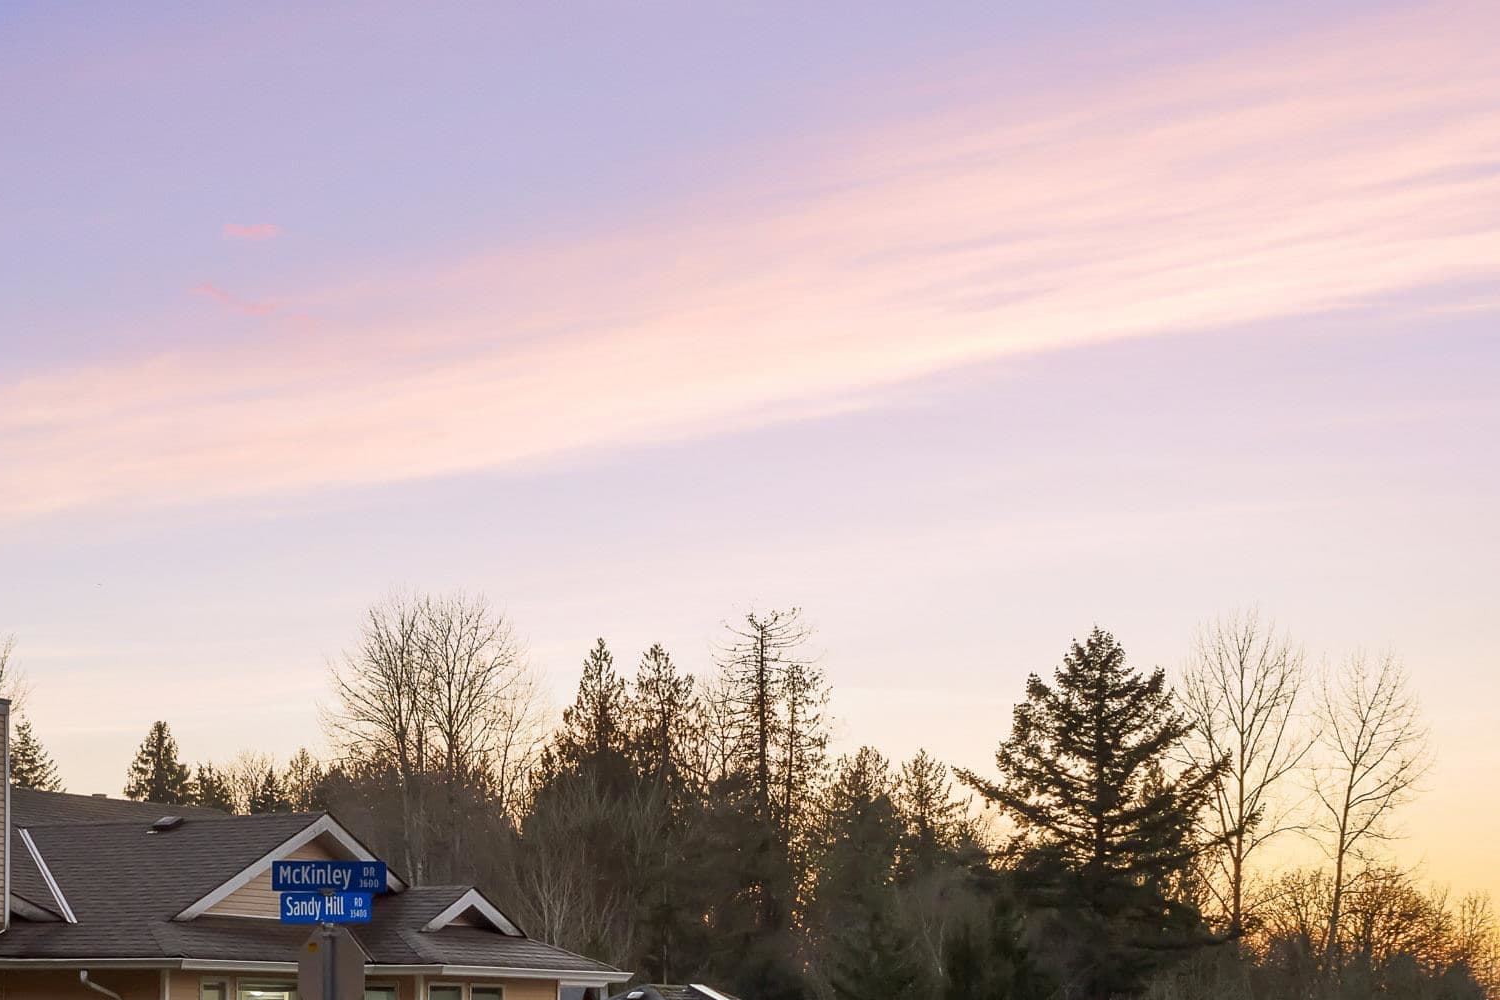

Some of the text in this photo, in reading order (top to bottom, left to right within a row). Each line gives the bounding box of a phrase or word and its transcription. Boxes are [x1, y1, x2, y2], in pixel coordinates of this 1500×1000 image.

[279, 864, 352, 890] McKinley
[363, 866, 375, 876] DR
[286, 896, 344, 920] Sandy Hill
[354, 897, 363, 907] RD
